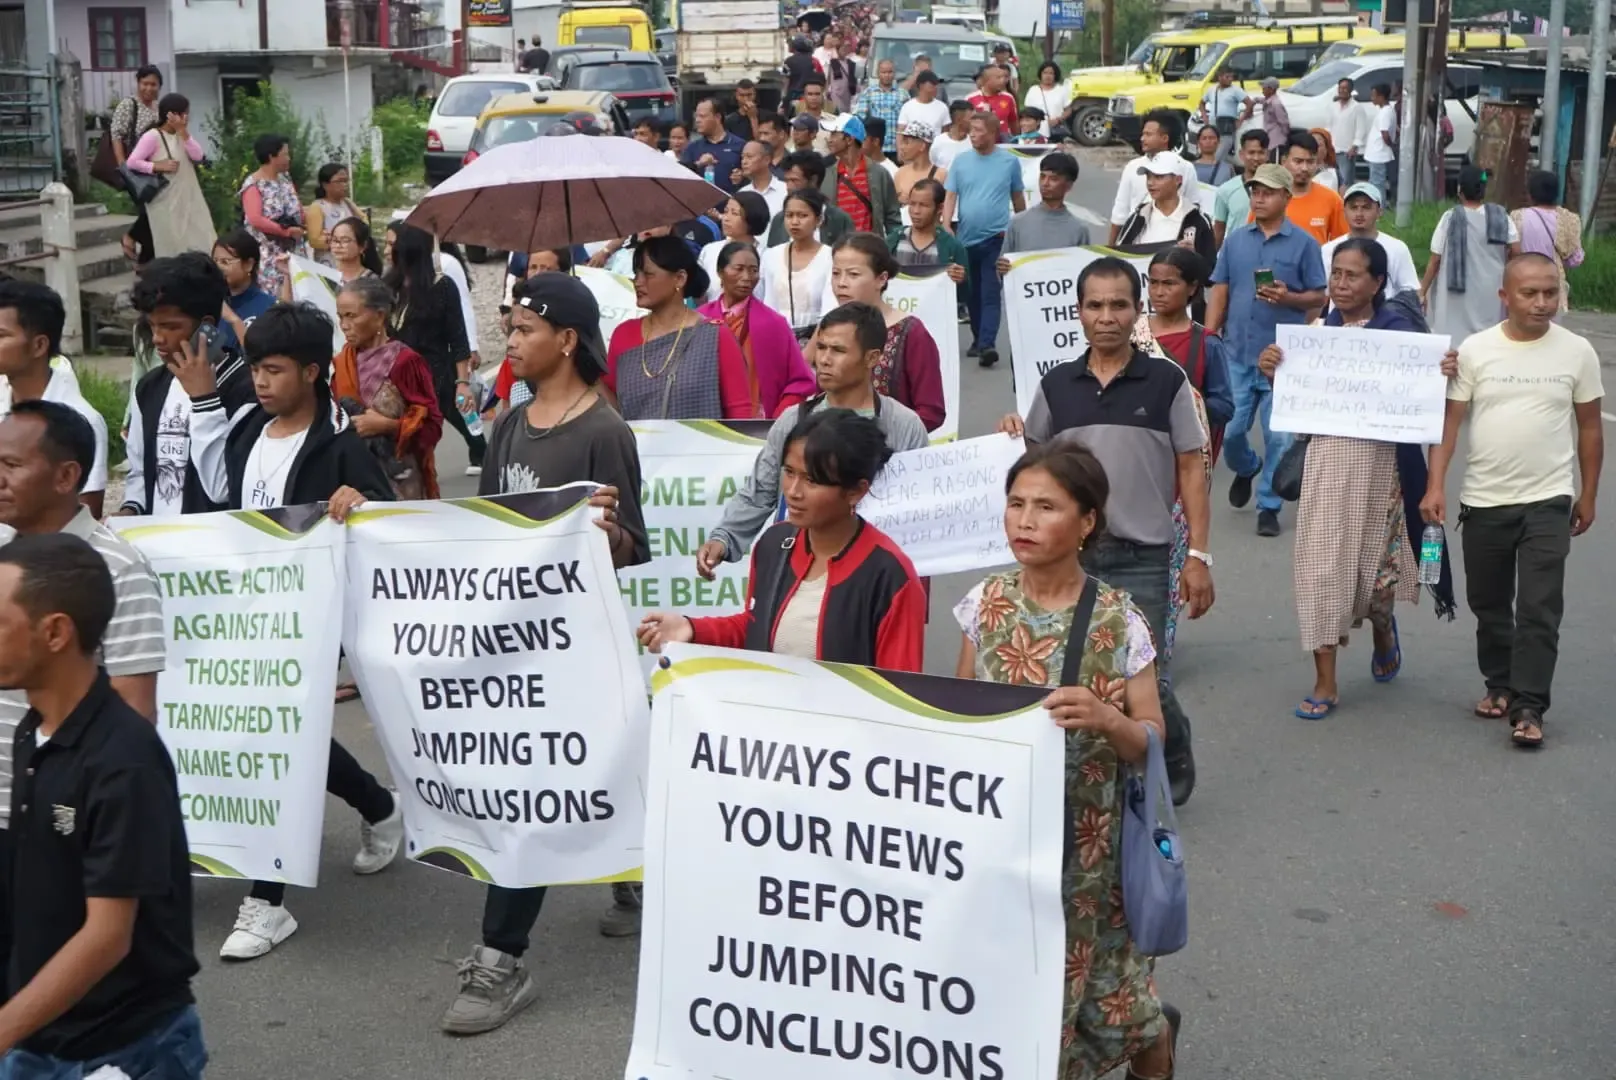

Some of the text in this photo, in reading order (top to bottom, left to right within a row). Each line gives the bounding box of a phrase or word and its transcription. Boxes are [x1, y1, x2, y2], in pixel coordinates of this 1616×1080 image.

[898, 296, 919, 312] OF
[1023, 278, 1073, 299] STOP
[1041, 305, 1079, 323] THE
[1053, 331, 1079, 349] OF
[1349, 338, 1383, 357] TRY
[1398, 344, 1422, 360] TO
[1284, 373, 1418, 397] THE POWER OF
[1279, 394, 1424, 416] MEGHALAYA POLICE
[933, 465, 997, 496] RASONG
[159, 564, 305, 598] TAKE ACTION
[371, 560, 587, 601] ALWAYS CHECK
[671, 577, 752, 608] BEA
[173, 611, 303, 641] AGAINST ALL
[393, 617, 572, 658] YOUR NEWS
[184, 658, 302, 687] THOSE WHO
[420, 674, 544, 710] BEFORE
[163, 702, 273, 734] TARNISHED
[411, 727, 588, 766] JUMPING TO
[176, 747, 233, 778] NAME
[237, 751, 264, 780] OF
[690, 732, 1005, 820] ALWAYS CHECK
[415, 777, 615, 824] CONCLUSIONS
[717, 801, 965, 882] YOUR NEWS
[758, 875, 924, 942] BEFORE
[708, 934, 976, 1016] JUMPING TO
[688, 996, 1005, 1080] CONCLUSIONS
